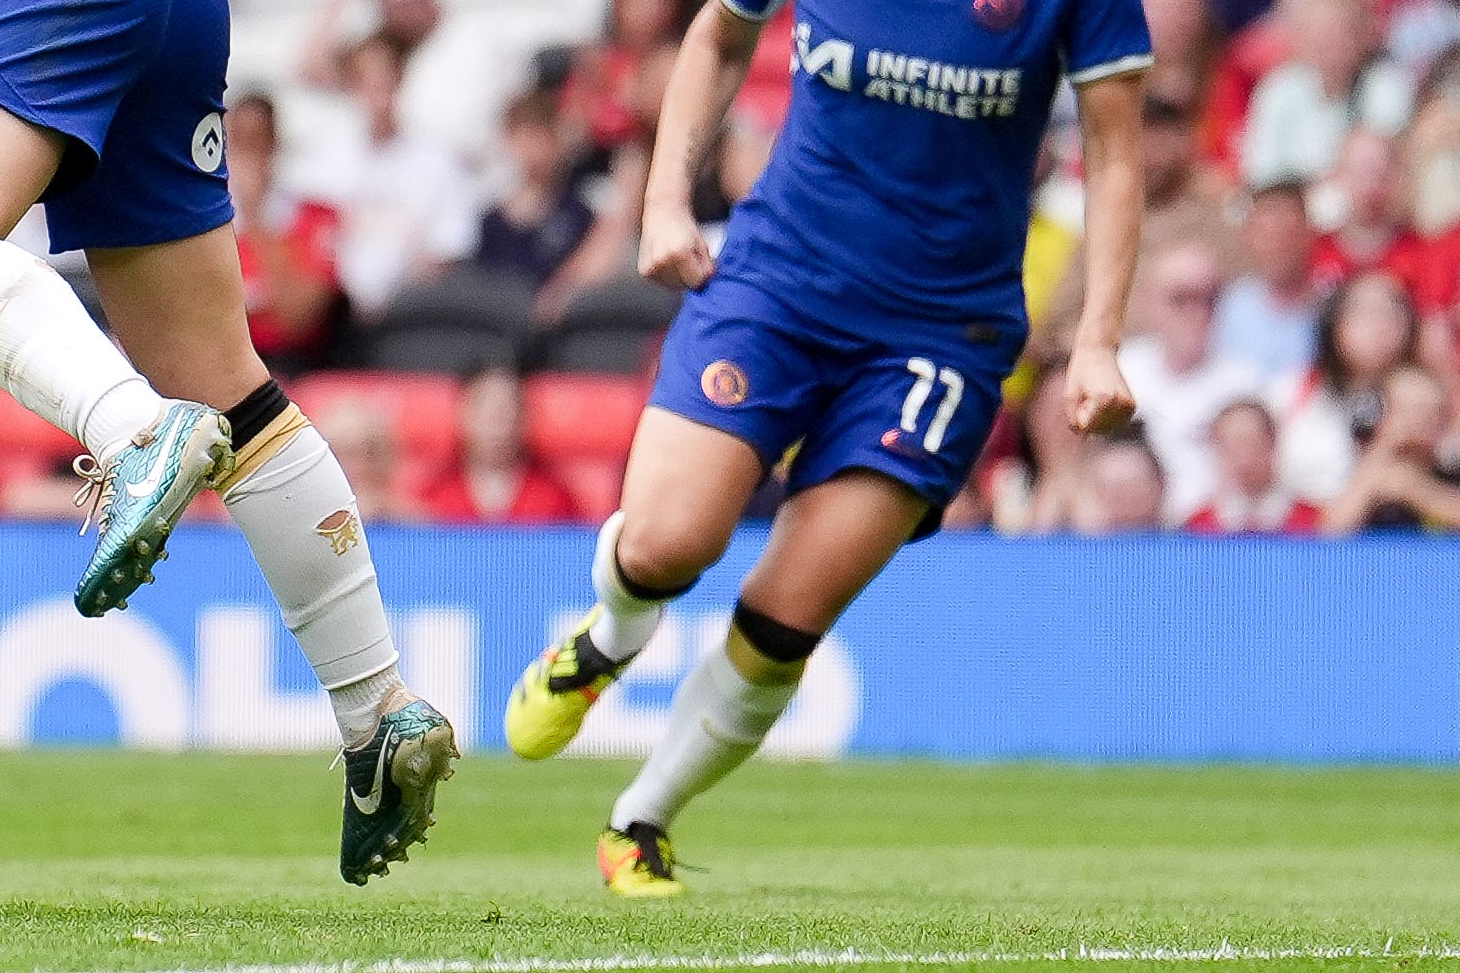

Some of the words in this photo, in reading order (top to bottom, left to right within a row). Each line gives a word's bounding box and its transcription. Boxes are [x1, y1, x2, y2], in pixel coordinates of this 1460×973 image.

[867, 48, 1021, 95] INFINITE
[864, 78, 1018, 120] ATHLETE
[900, 356, 965, 455] 11
